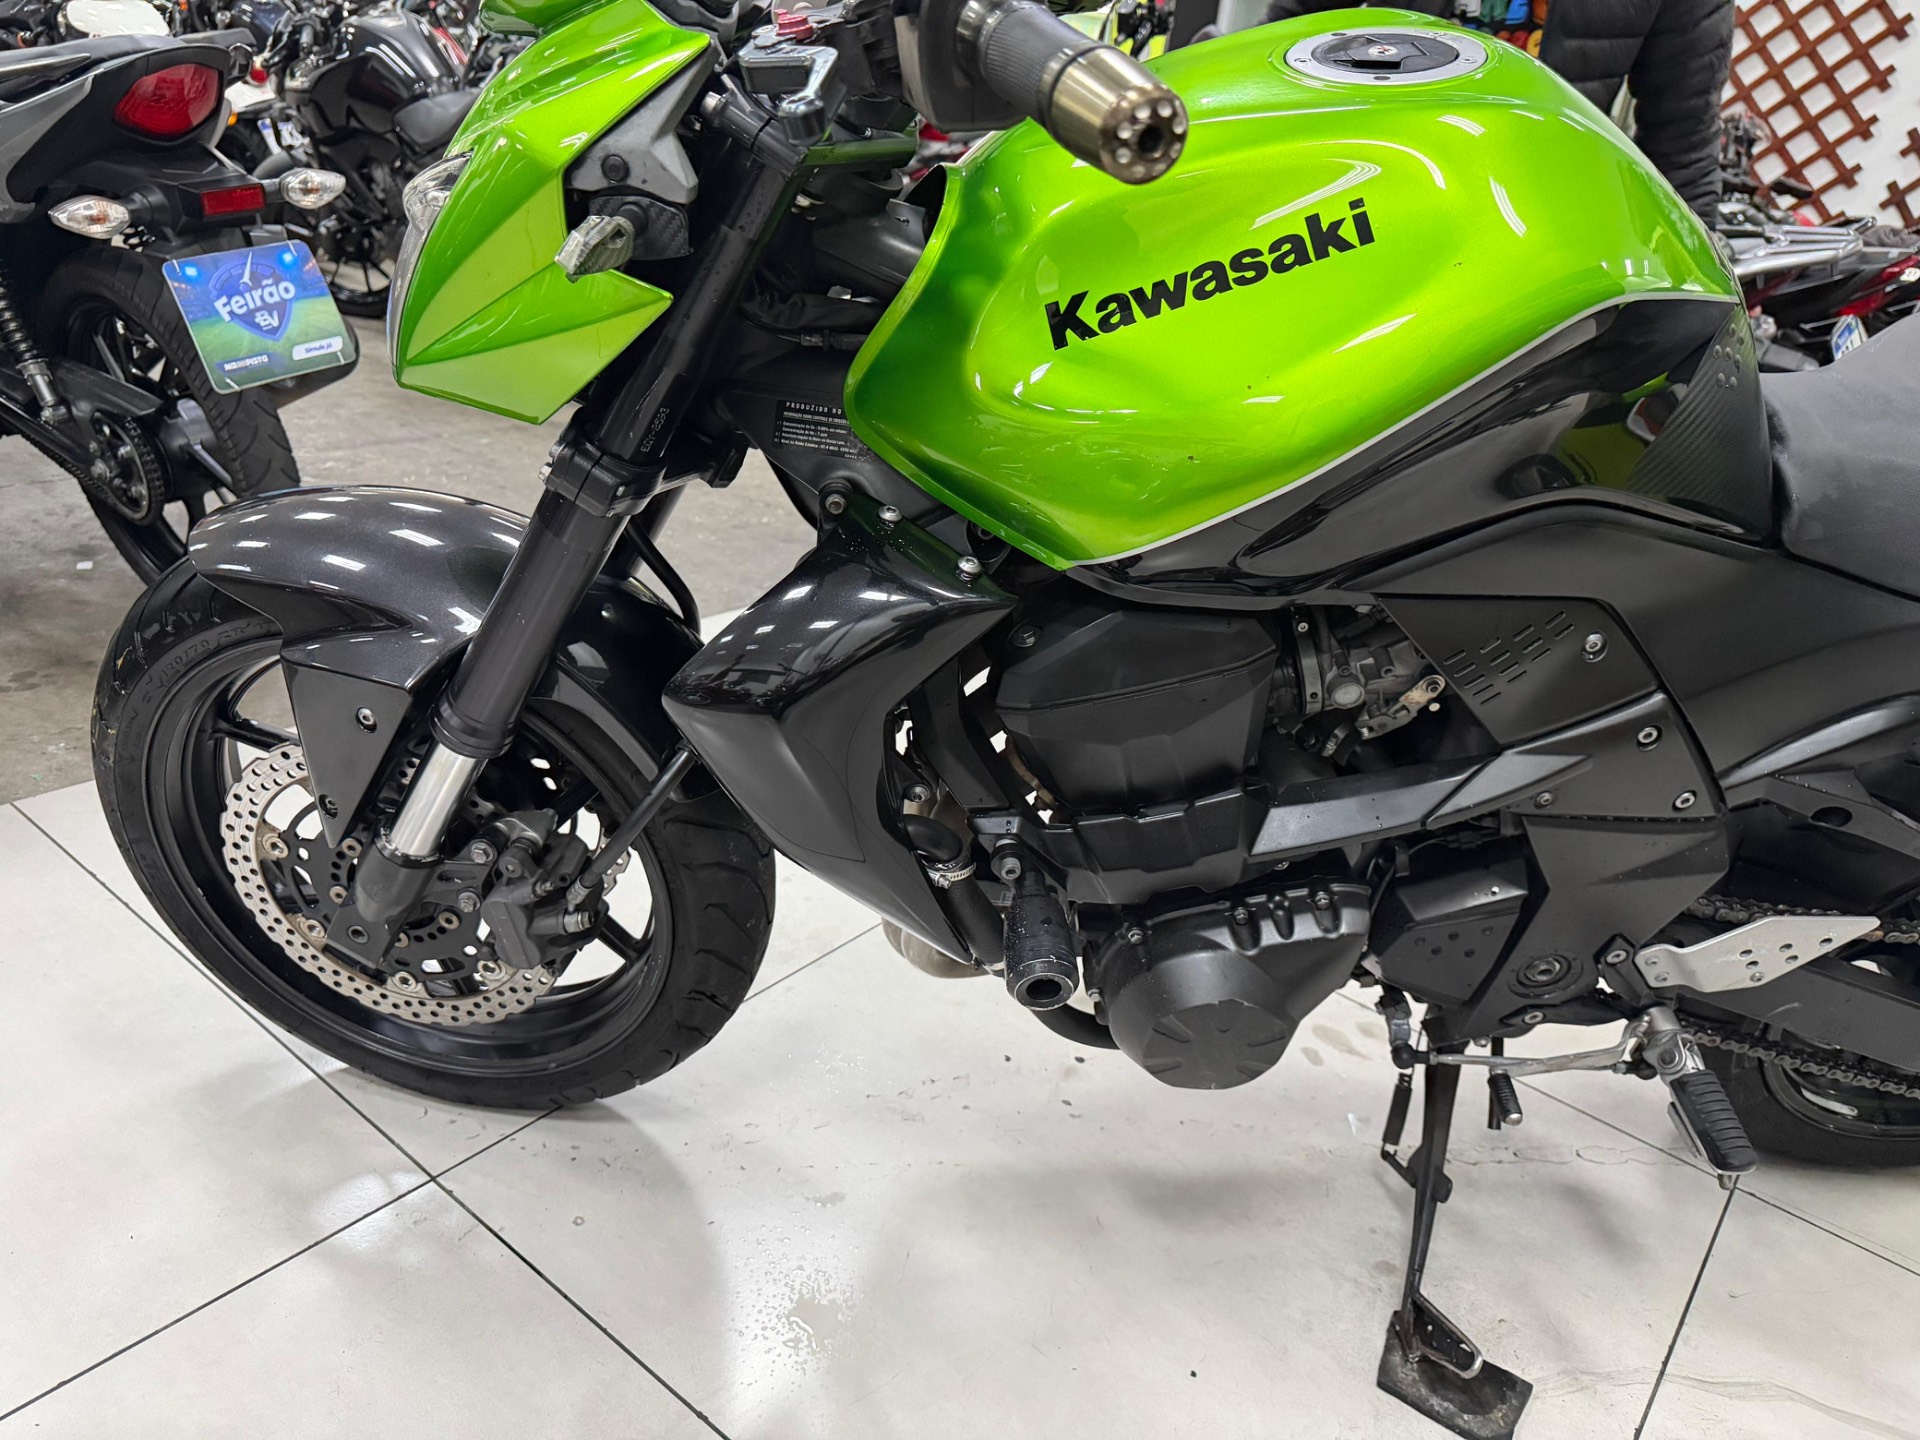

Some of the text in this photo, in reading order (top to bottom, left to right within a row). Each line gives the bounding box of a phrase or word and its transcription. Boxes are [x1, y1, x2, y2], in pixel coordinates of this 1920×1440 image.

[1044, 197, 1375, 351] Kawasaki
[213, 278, 296, 322] Feirão
[785, 401, 828, 413] PRODUZIDO
